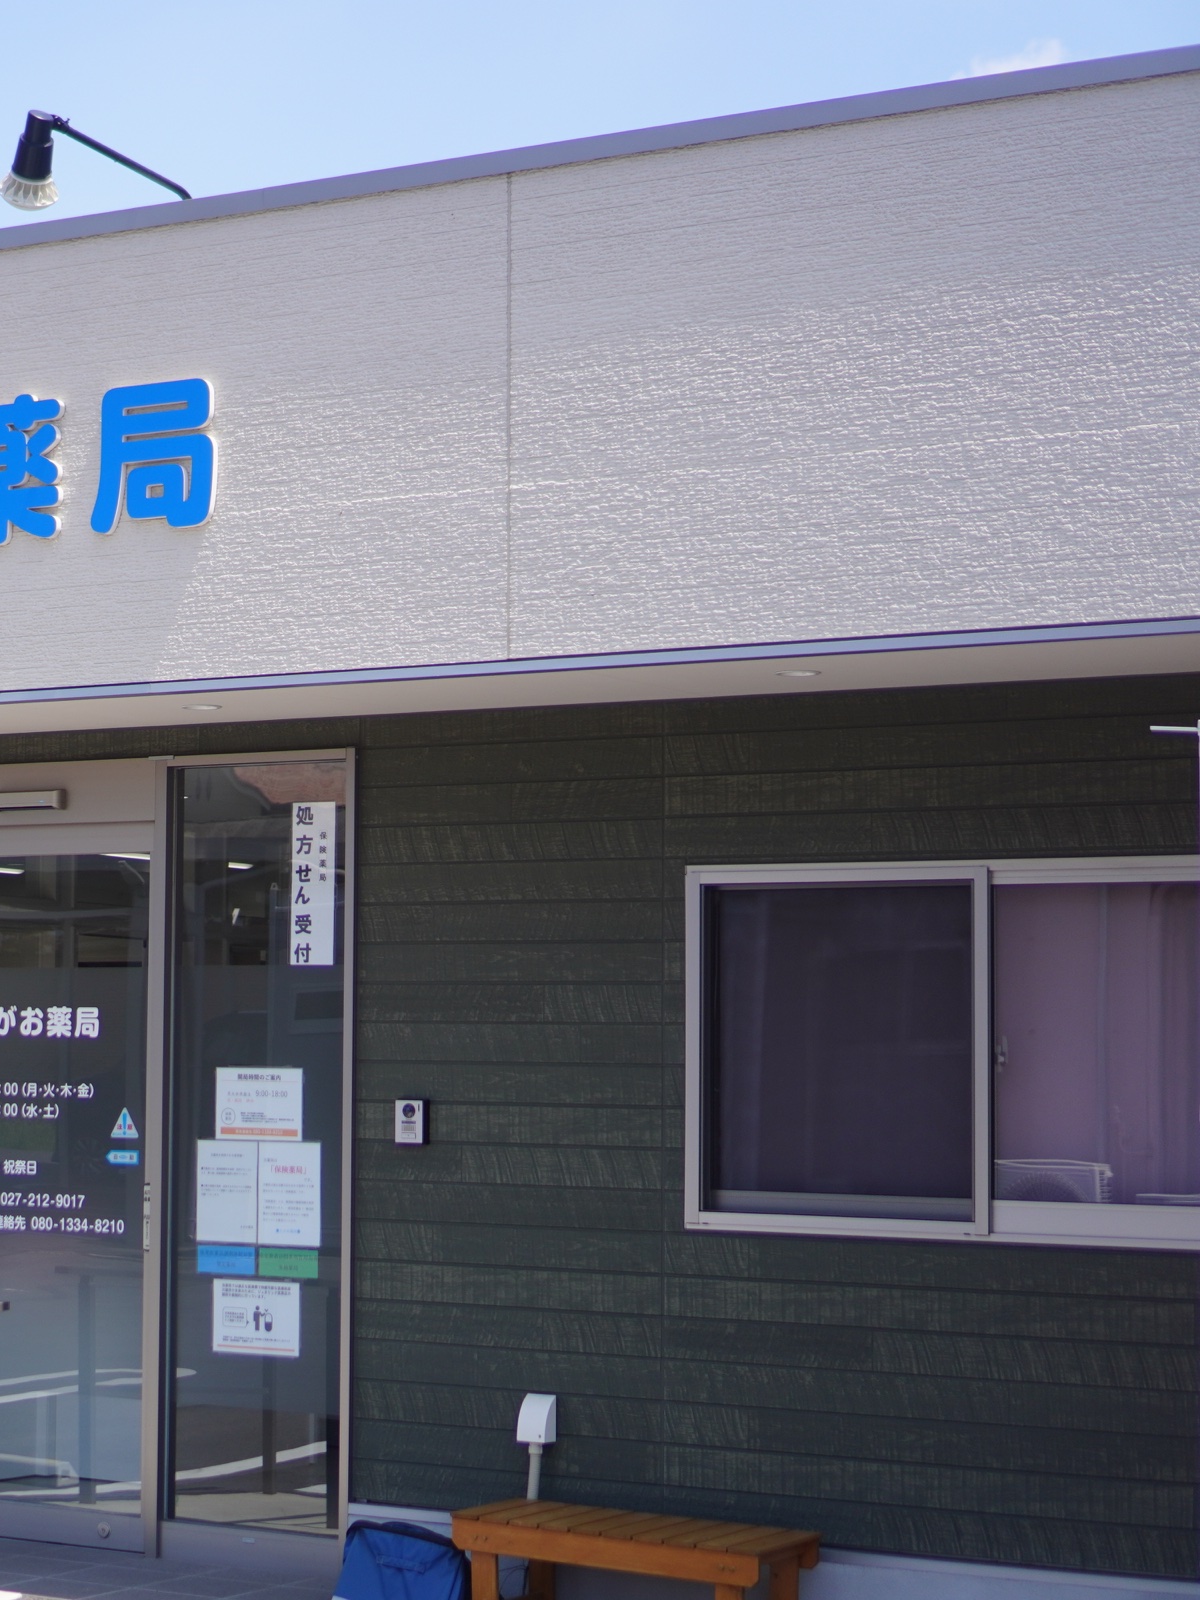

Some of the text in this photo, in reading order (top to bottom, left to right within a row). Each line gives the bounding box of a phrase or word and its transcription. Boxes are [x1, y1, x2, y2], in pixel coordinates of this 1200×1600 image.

[318, 831, 327, 882] 保険薬局
[294, 805, 314, 963] 処方せん受付
[0, 1192, 86, 1208] 027-212-9017
[31, 1216, 125, 1234] 080-1334-8210
